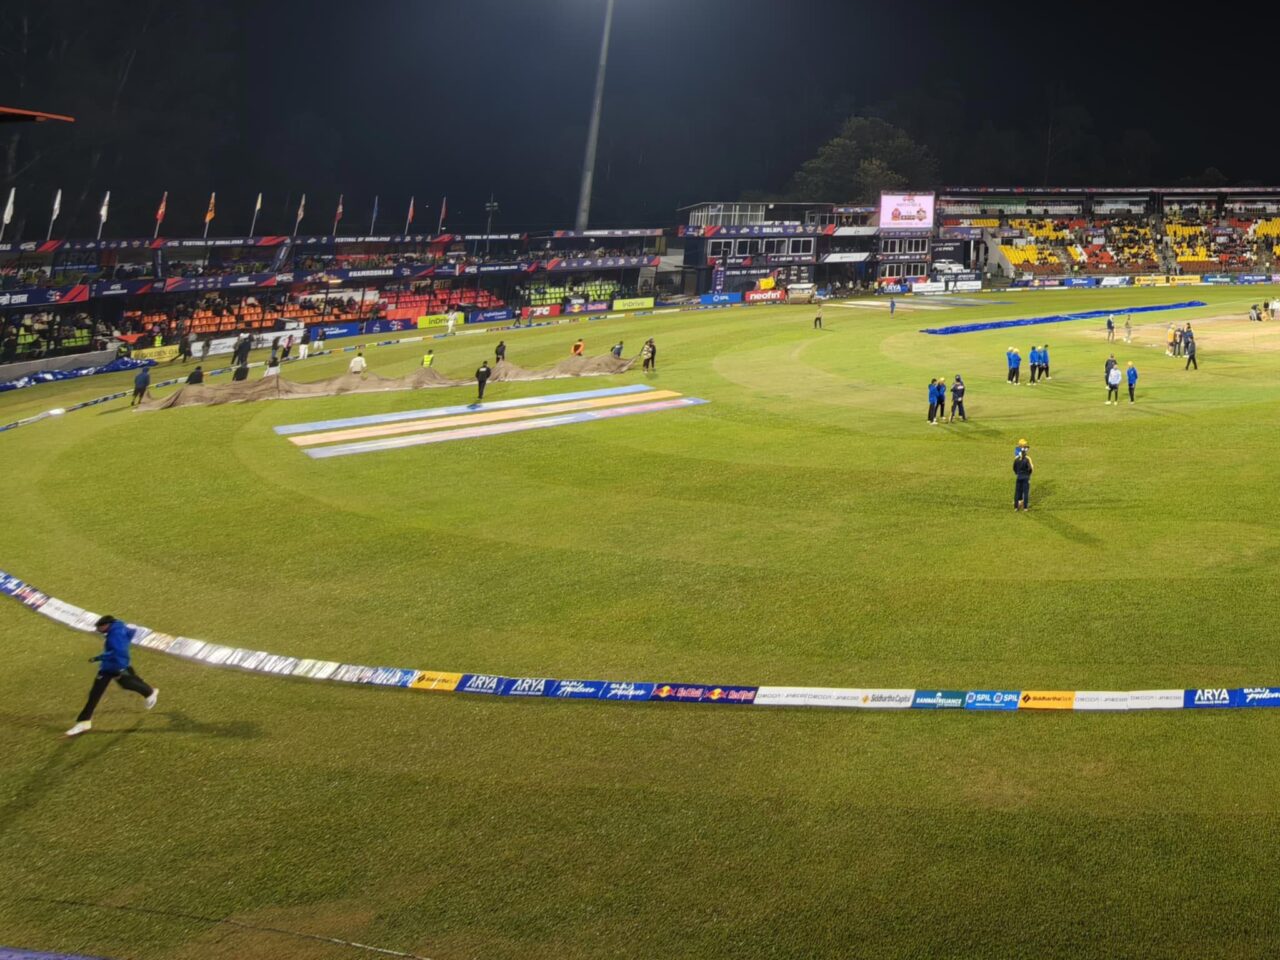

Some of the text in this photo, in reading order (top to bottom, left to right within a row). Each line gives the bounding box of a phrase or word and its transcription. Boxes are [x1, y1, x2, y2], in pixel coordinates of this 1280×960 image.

[466, 676, 498, 689] ARYA
[512, 679, 546, 691] ARYA
[871, 694, 910, 703] Siddhartha Capital
[1194, 689, 1230, 701] ARYA
